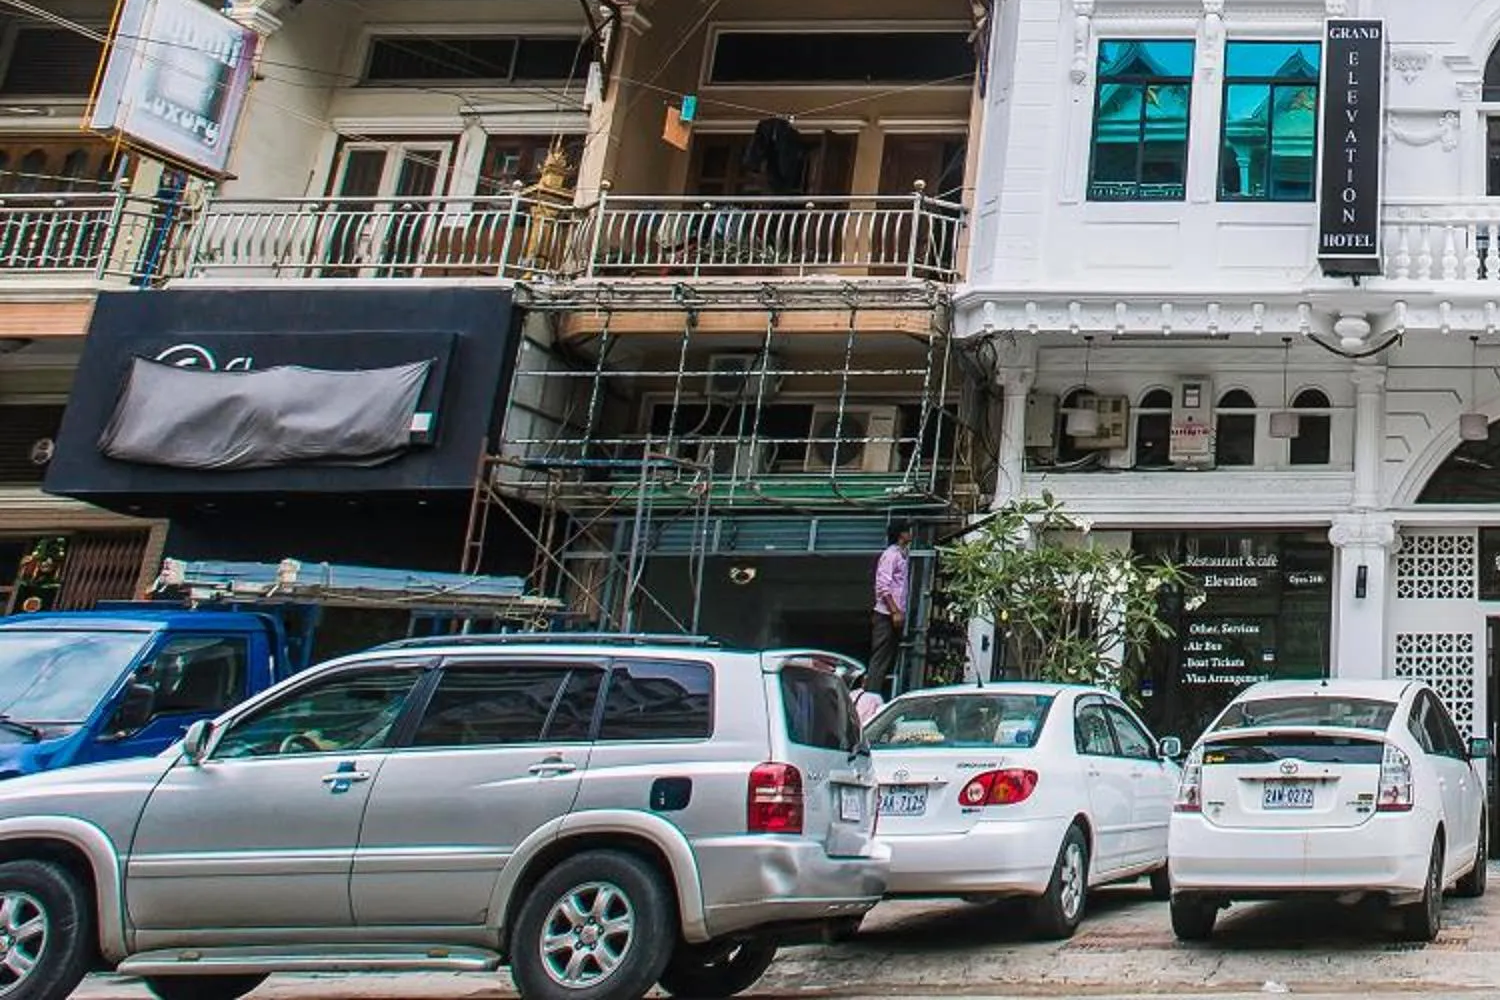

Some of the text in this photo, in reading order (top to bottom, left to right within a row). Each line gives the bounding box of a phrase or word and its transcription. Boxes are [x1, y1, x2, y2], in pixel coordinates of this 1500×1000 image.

[1329, 27, 1379, 39] GRAND
[137, 87, 221, 147] Luxury
[1342, 51, 1359, 223] ELEVATION
[1323, 235, 1374, 247] HOTEL
[1204, 576, 1258, 587] Elevation
